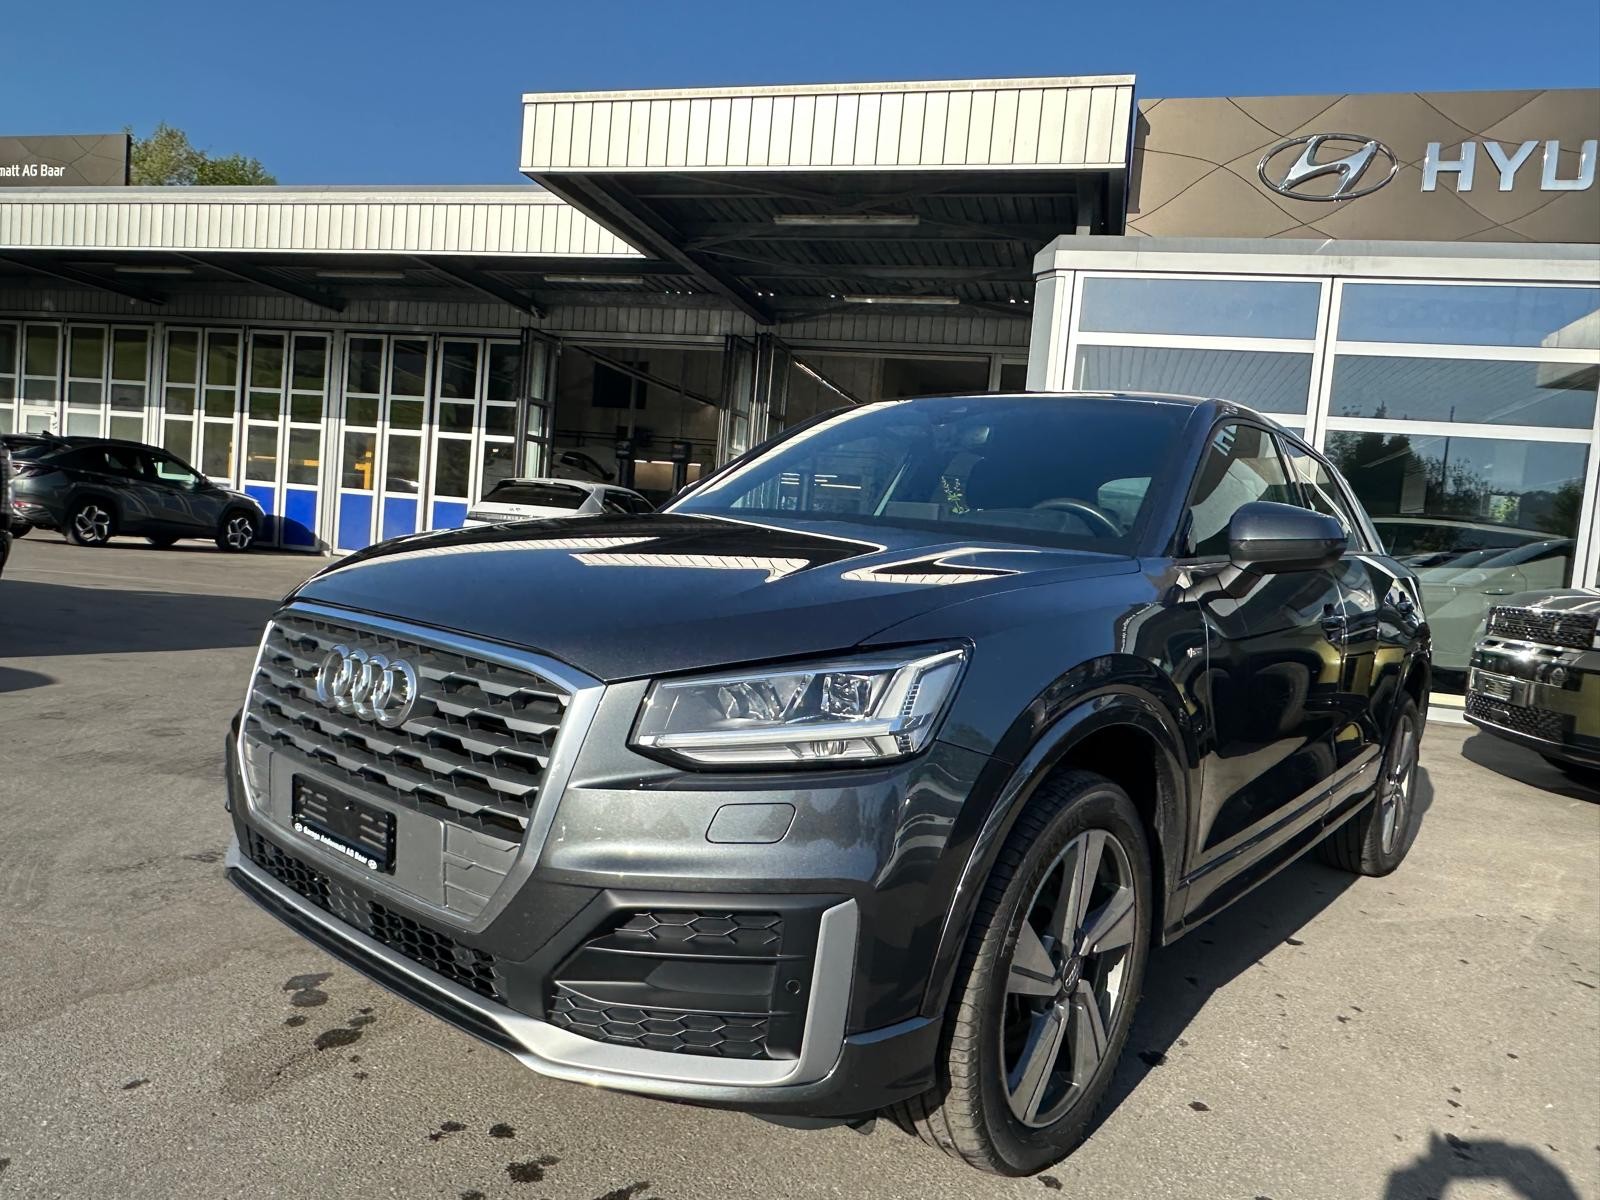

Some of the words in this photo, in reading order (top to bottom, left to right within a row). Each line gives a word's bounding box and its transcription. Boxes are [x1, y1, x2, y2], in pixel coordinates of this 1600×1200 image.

[22, 164, 38, 177] AG
[40, 164, 66, 177] Baar
[1421, 139, 1598, 193] HYU
